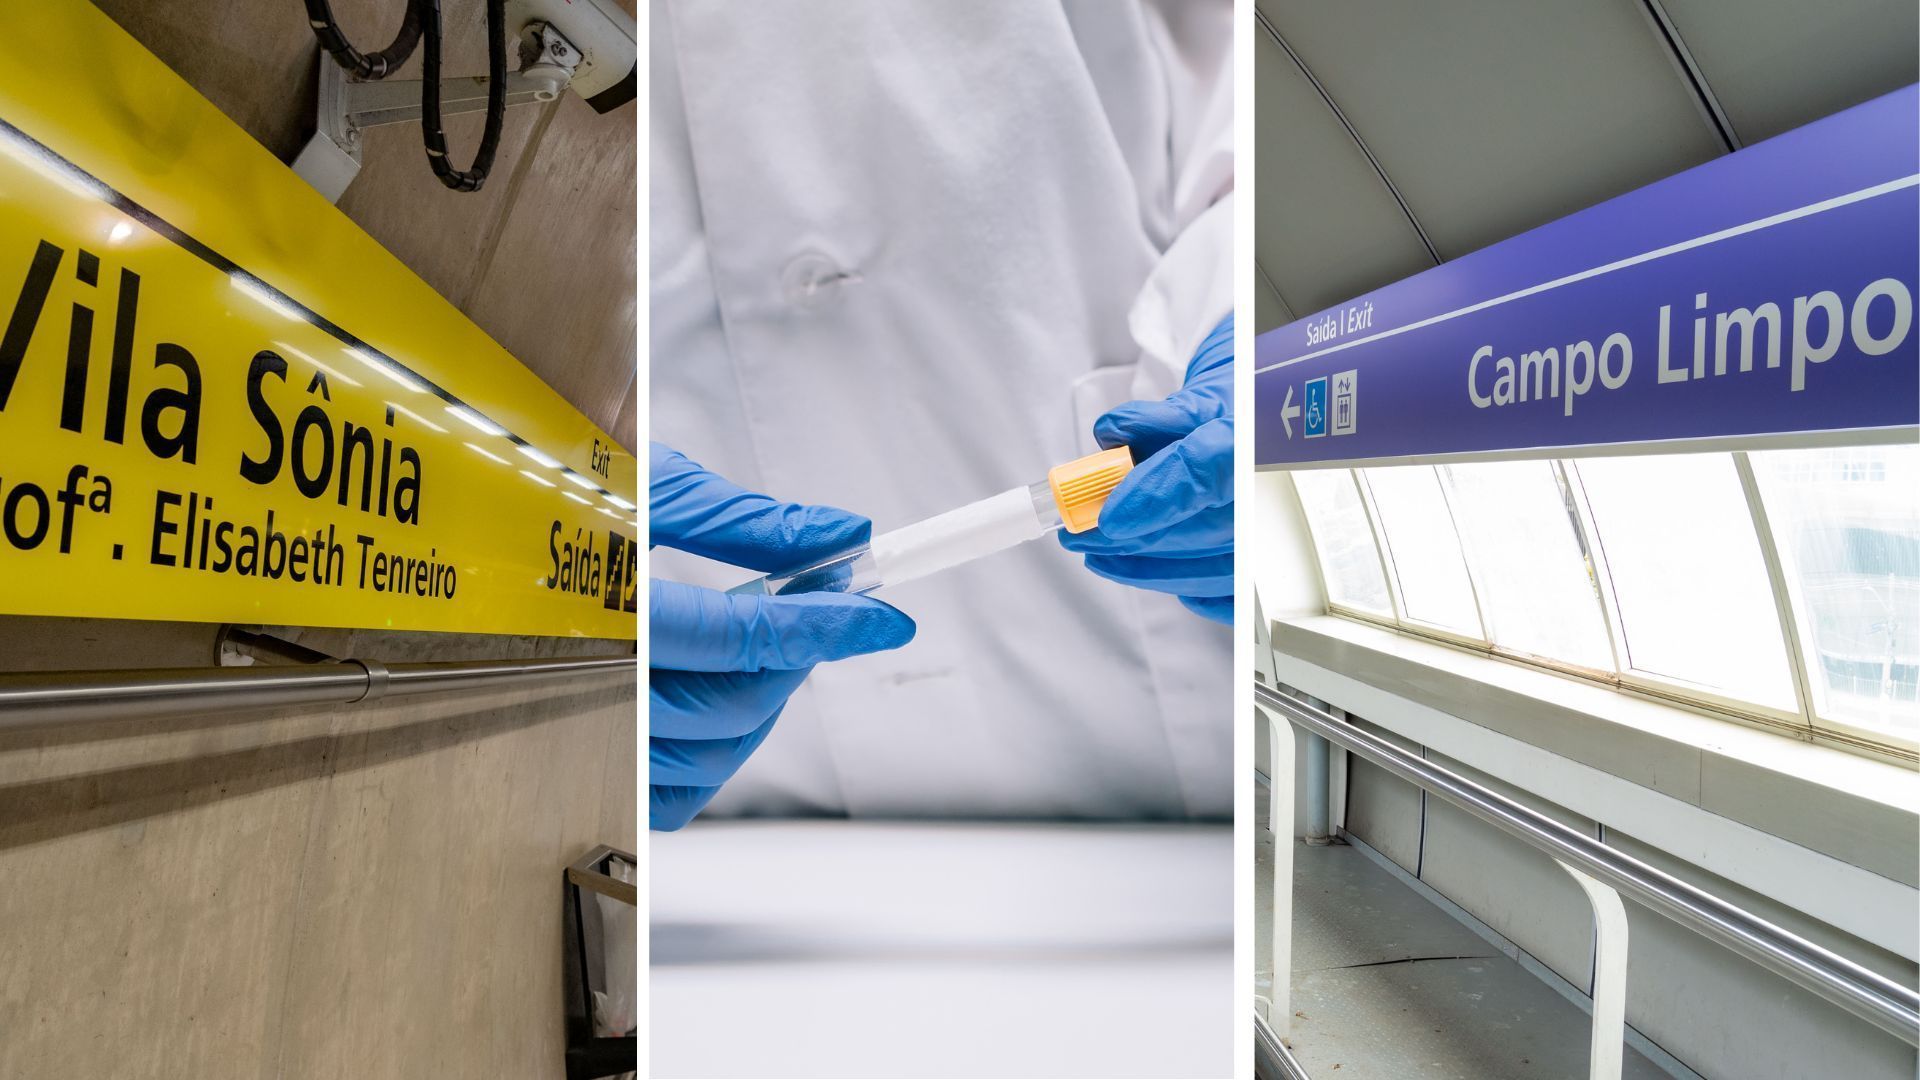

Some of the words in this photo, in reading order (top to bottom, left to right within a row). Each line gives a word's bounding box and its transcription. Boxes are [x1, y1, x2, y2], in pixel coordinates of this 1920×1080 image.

[1306, 315, 1336, 347] Saída
[1347, 301, 1374, 334] Exit
[1468, 332, 1633, 416] Campo
[1658, 278, 1913, 391] Limpo
[240, 349, 422, 525] Sônia
[591, 438, 611, 479] Exit
[0, 464, 123, 560] ofª.
[150, 490, 344, 587] Elisabeth
[357, 535, 457, 599] Tenreiro
[547, 520, 601, 597] Saída
